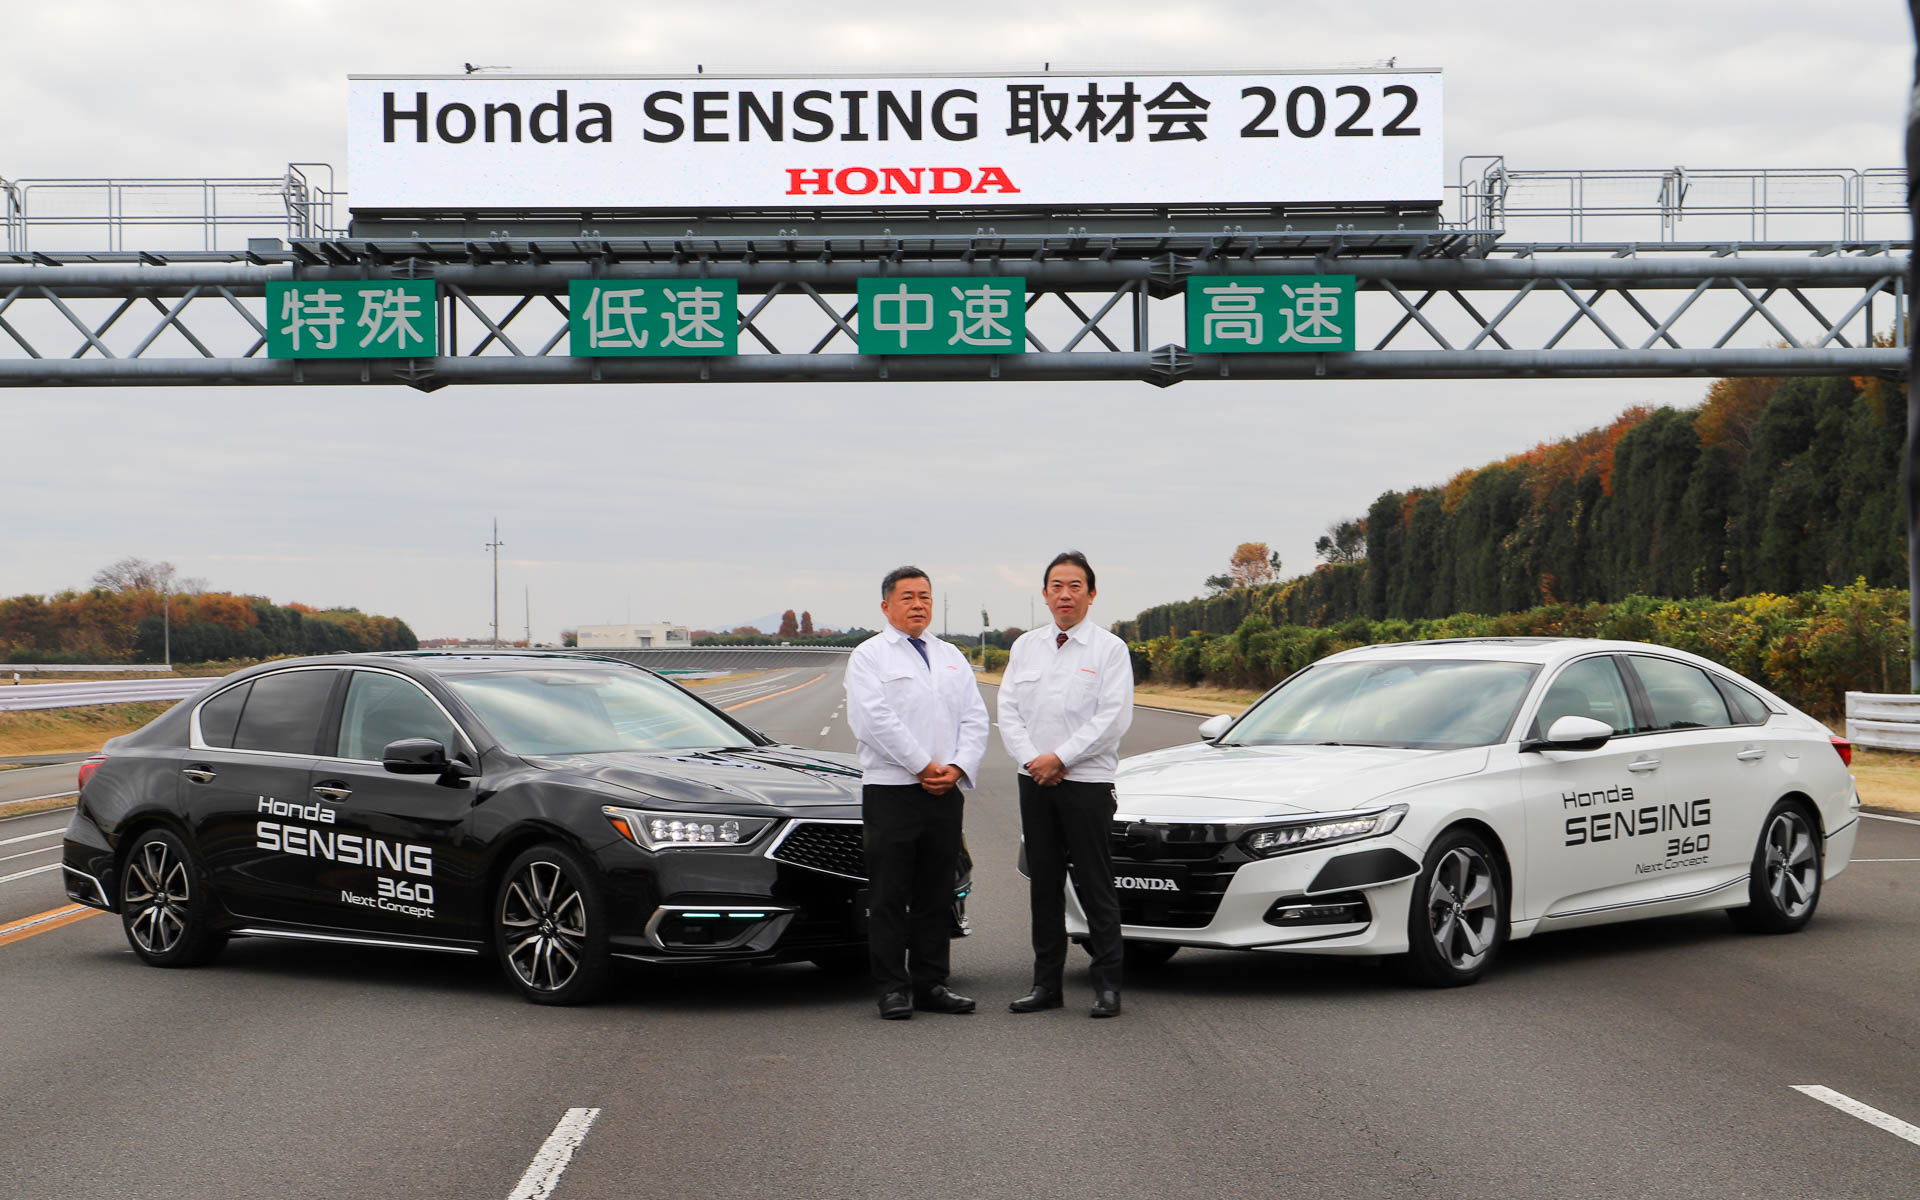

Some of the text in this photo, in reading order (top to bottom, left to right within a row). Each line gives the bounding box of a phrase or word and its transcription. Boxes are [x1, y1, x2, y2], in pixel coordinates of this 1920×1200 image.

[383, 81, 1421, 144] Honda SENSING 取材会 2022
[785, 167, 1021, 195] HONDA
[281, 287, 424, 351] 特殊
[582, 286, 724, 350] 低速
[872, 283, 1012, 349] 中速
[1203, 282, 1343, 345] 高速
[257, 796, 336, 823] Honda
[1562, 784, 1635, 809] Honda
[1565, 798, 1711, 847] SENSING
[256, 821, 433, 876] SENSING
[1666, 834, 1710, 857] 360
[1634, 855, 1709, 875] Next Concept
[341, 890, 435, 918] Next Concept
[377, 876, 434, 904] 360
